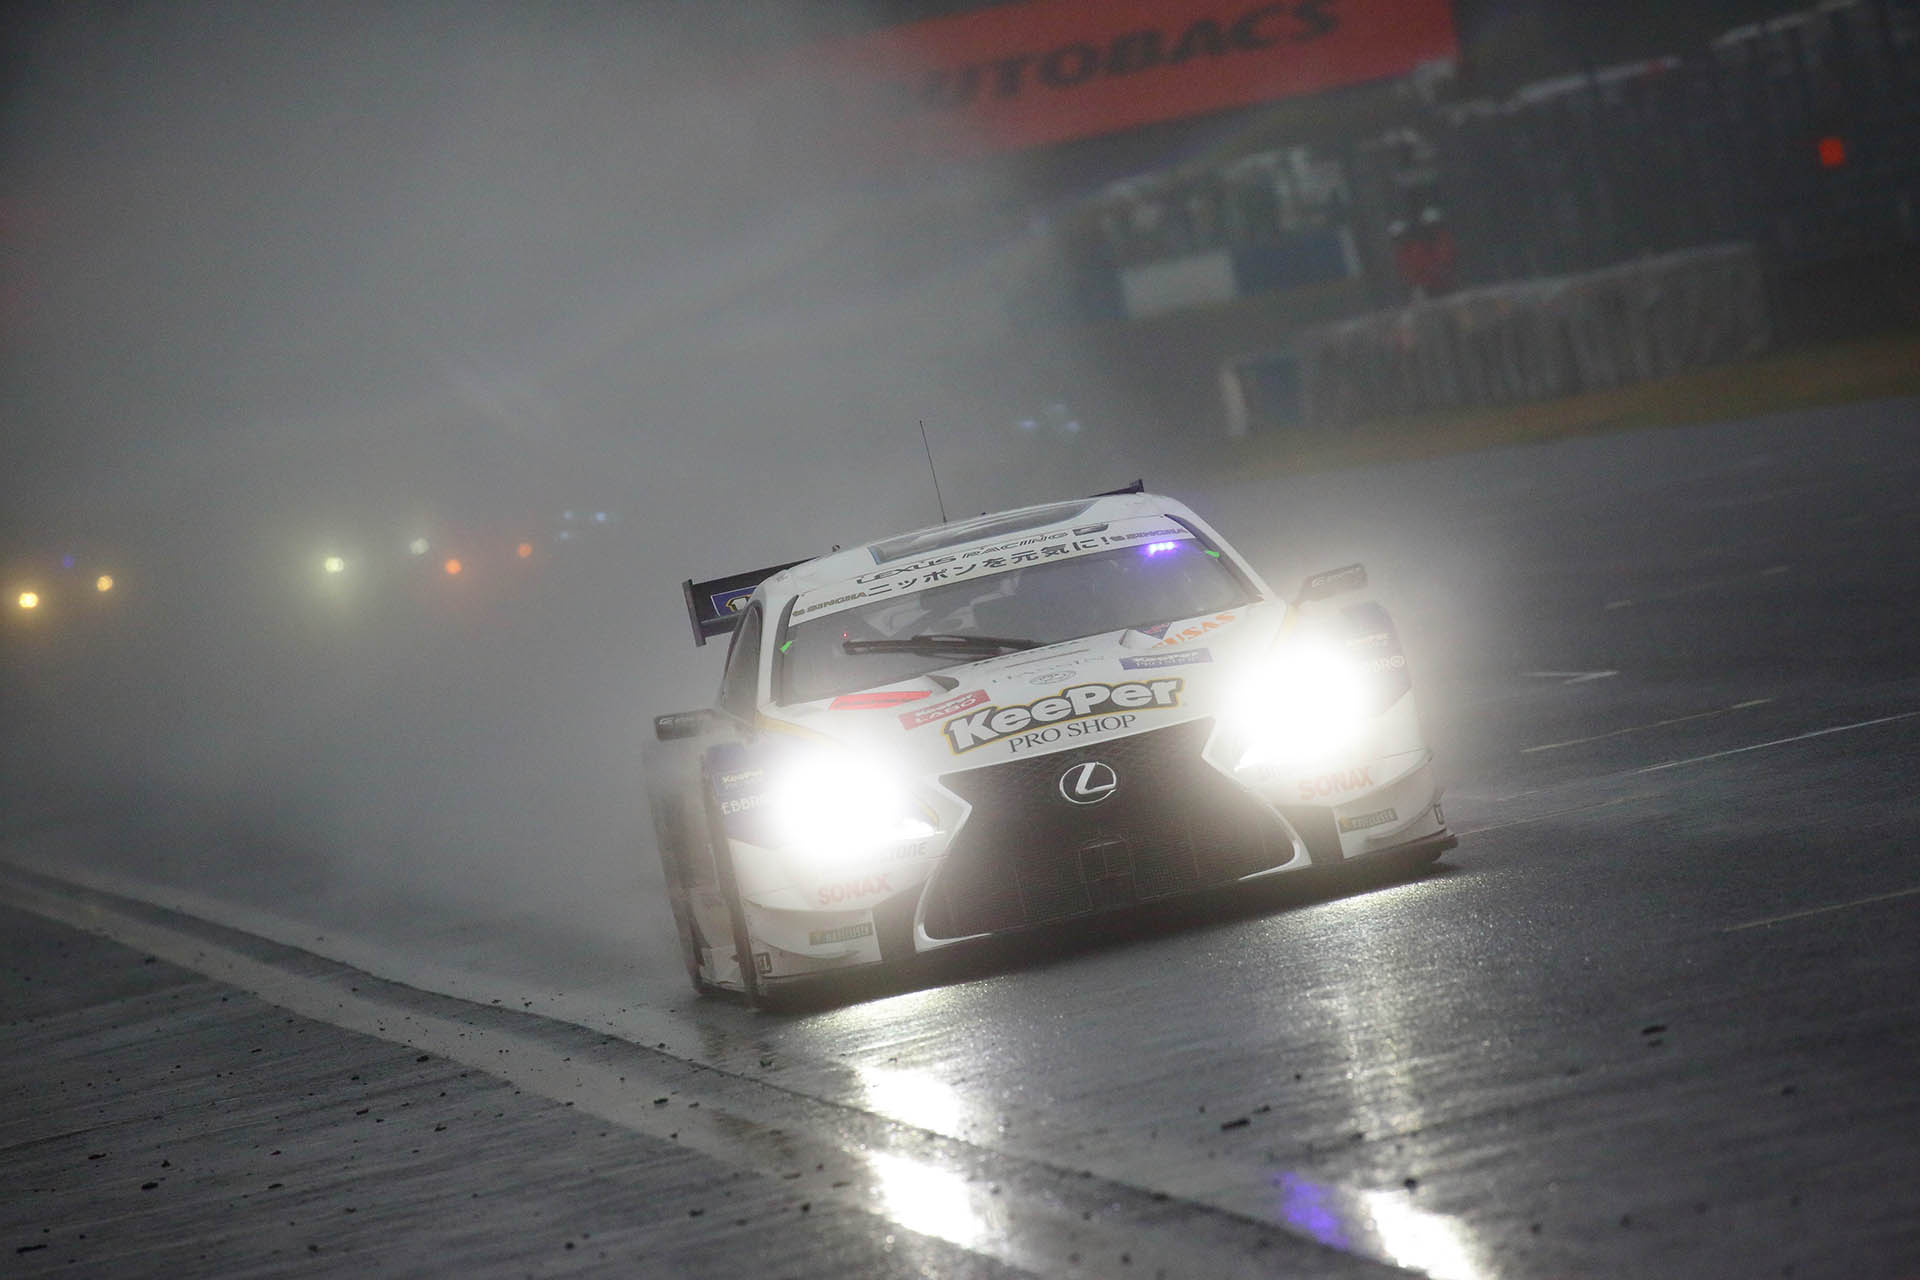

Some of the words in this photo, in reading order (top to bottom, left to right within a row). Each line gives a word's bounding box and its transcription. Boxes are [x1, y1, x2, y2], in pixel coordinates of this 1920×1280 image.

[905, 0, 1340, 110] UTOBACS
[857, 555, 957, 584] LEXUS
[962, 531, 1069, 558] RACING
[948, 678, 1180, 752] KeePer
[1009, 728, 1062, 753] PRO
[1067, 714, 1137, 738] SHOP
[1298, 766, 1373, 801] SONAX
[818, 873, 893, 905] SONAX
